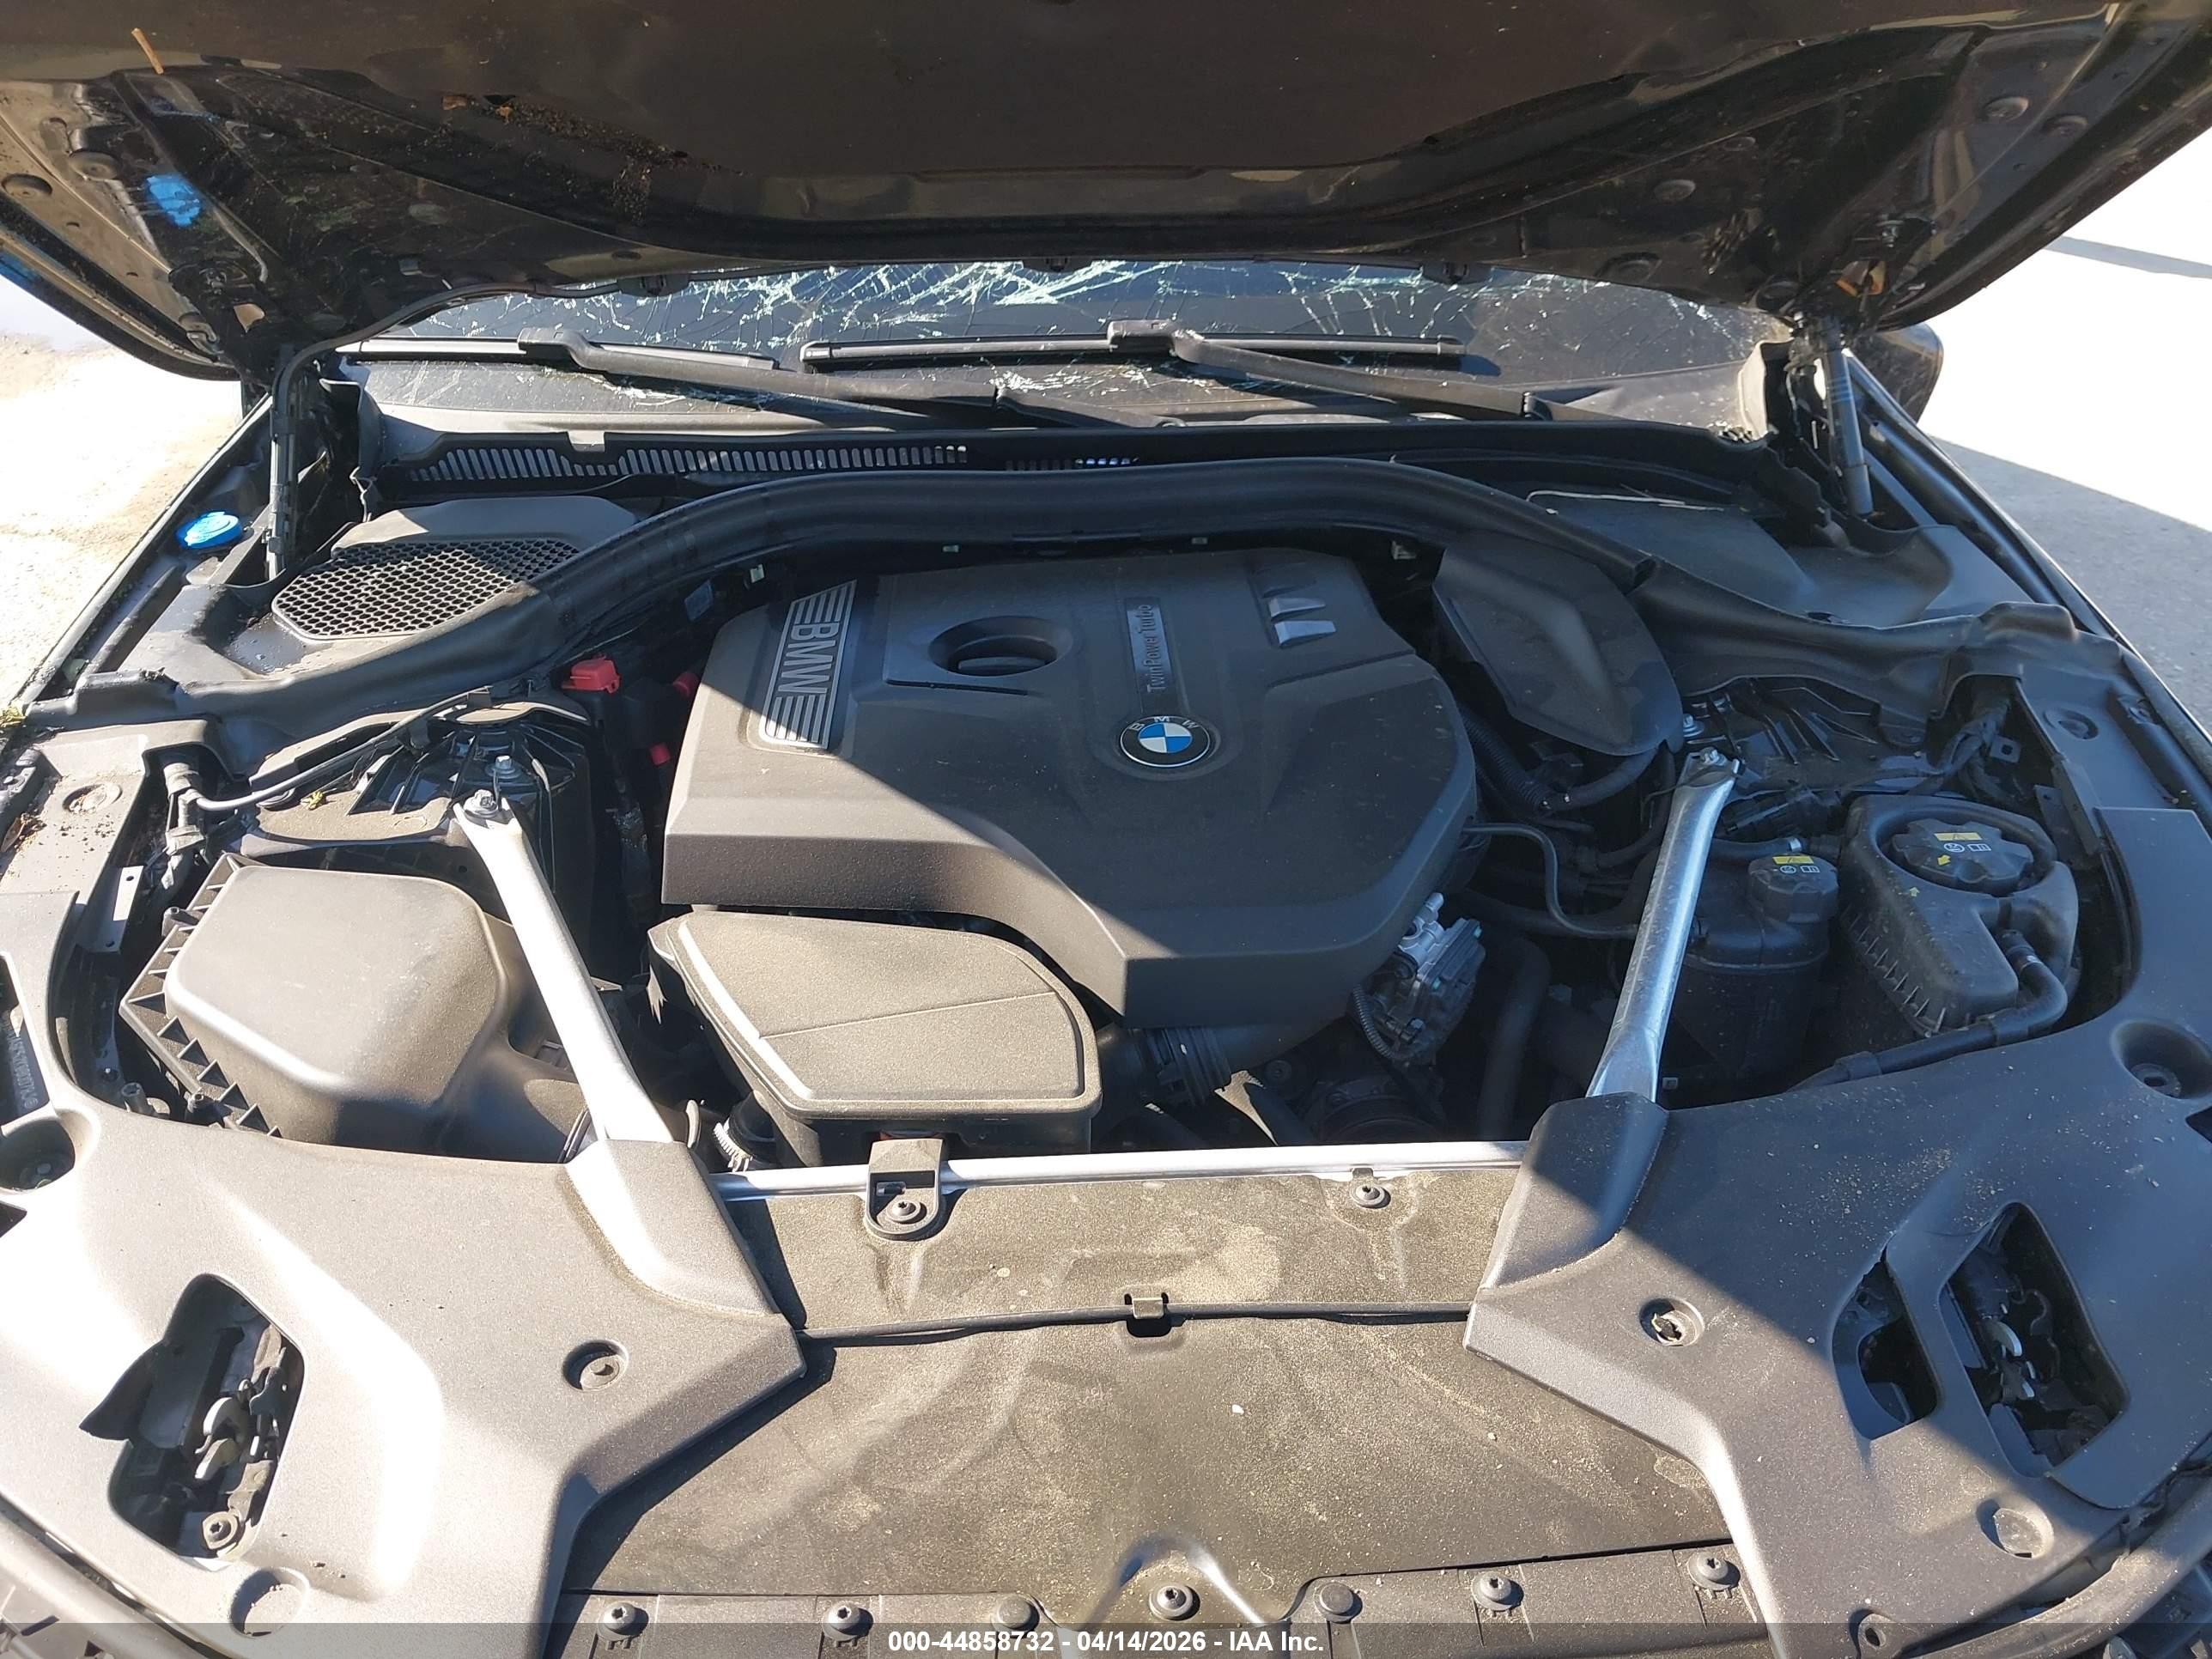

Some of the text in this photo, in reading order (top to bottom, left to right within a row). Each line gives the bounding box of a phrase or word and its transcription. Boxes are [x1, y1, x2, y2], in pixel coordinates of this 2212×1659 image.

[778, 622, 840, 693] BMW
[1136, 604, 1167, 694] TwinPower Turbo
[1128, 715, 1200, 732] BMW
